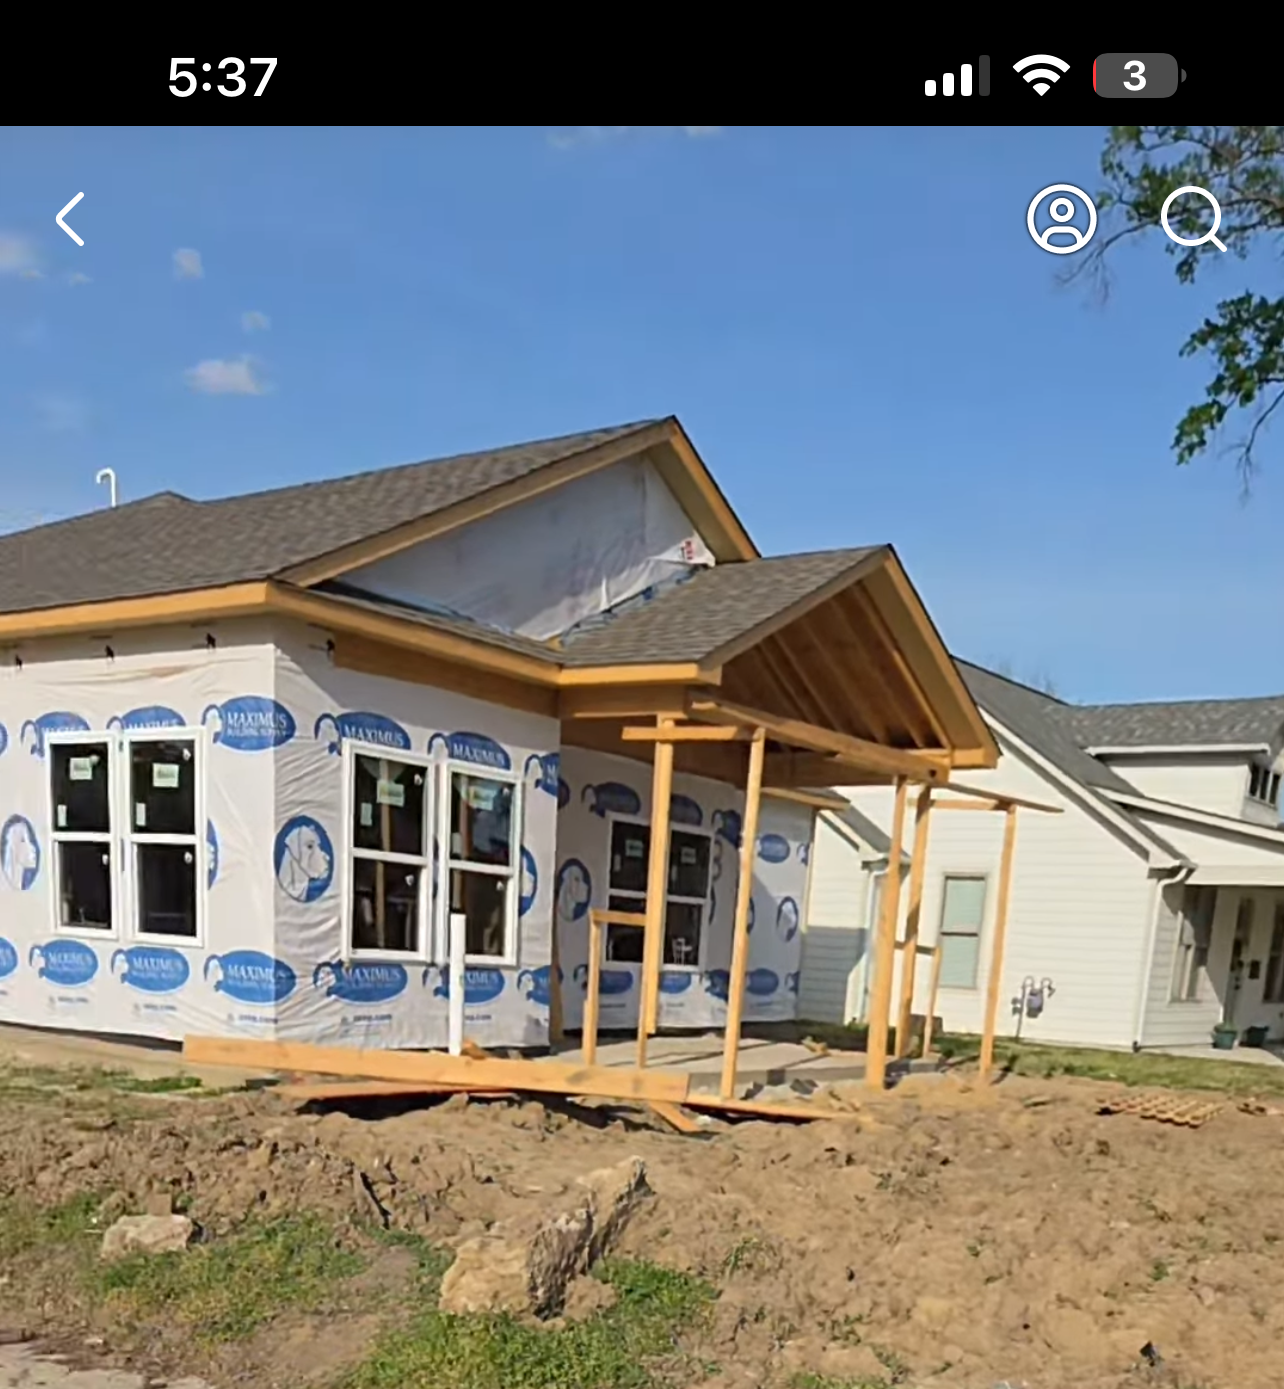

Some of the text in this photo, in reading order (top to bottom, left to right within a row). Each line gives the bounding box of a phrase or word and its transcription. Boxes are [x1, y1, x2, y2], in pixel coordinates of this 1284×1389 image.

[227, 711, 287, 729] MAXIMUS
[344, 723, 405, 747] MAXIMUS
[132, 956, 184, 972] MAXIMUS
